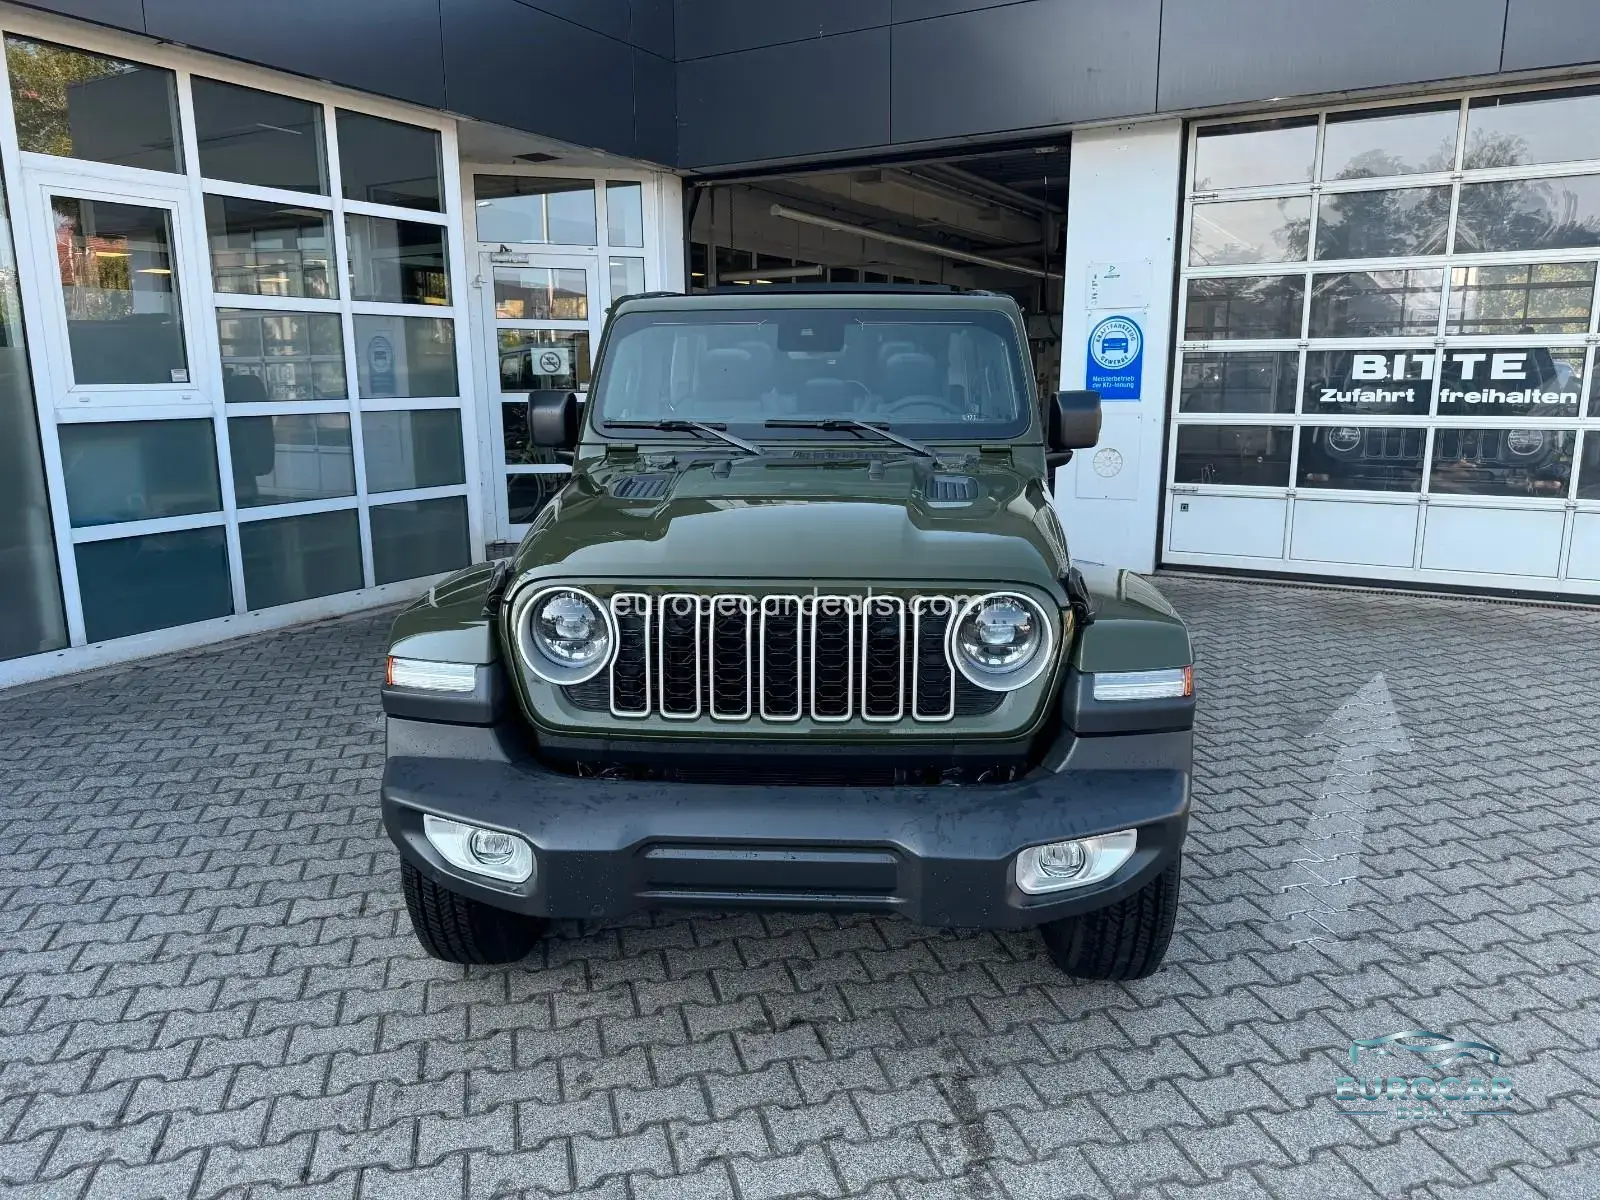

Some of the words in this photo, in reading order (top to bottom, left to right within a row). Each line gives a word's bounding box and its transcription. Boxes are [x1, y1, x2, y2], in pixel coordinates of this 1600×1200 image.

[1096, 323, 1136, 343] KRAFTFAHRZEUG
[1100, 354, 1129, 365] GEWERBE
[1351, 353, 1527, 381] BITTE
[1320, 388, 1415, 403] Zufahrt
[1439, 388, 1577, 404] freihalten
